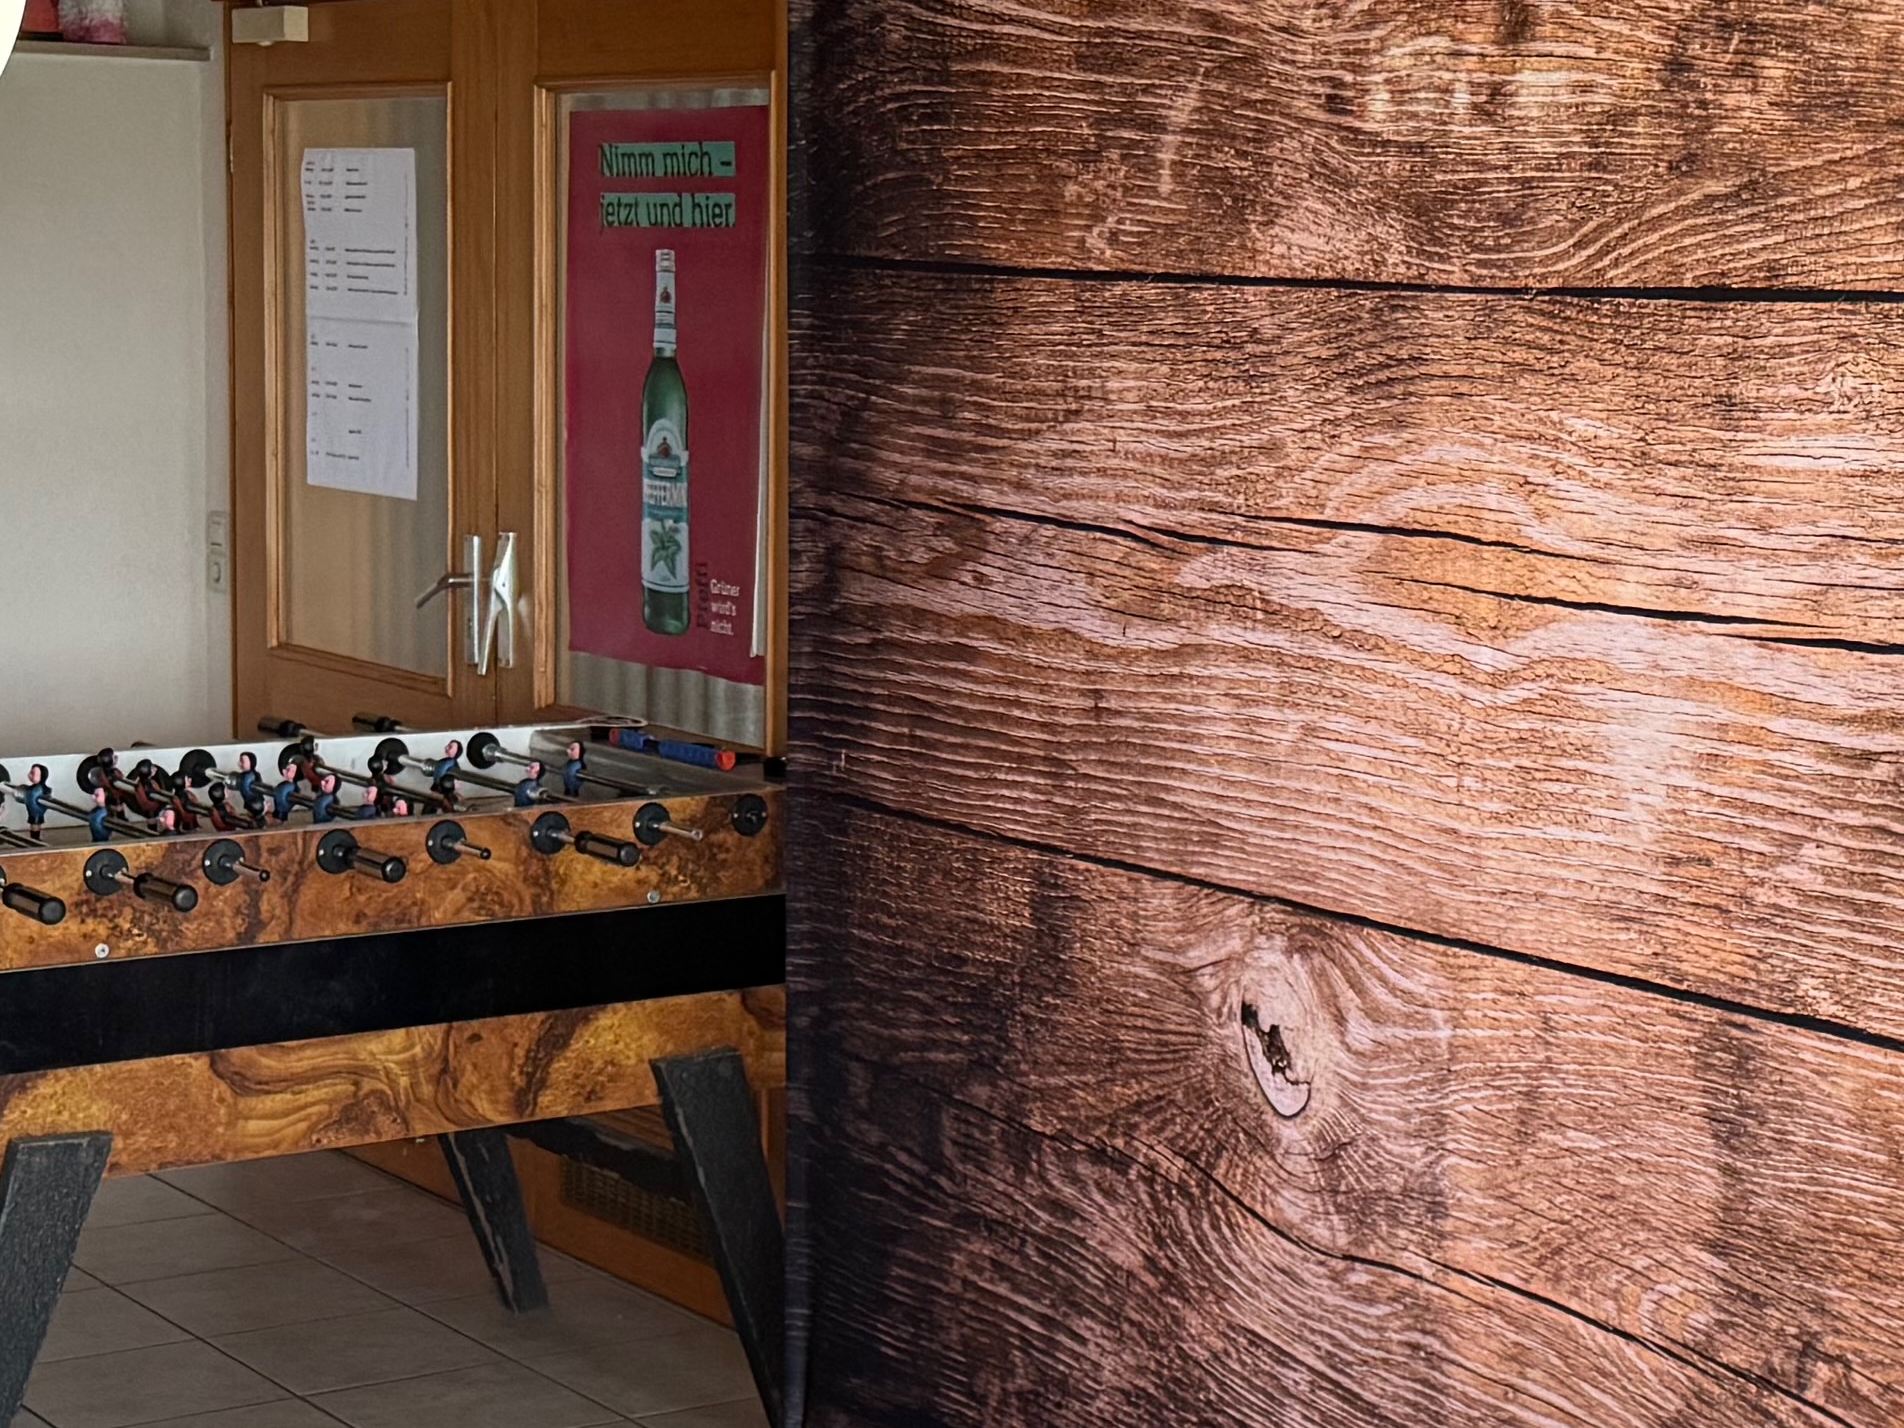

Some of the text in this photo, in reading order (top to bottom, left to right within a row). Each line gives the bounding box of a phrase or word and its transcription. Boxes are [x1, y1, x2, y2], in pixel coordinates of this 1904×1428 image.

[599, 143, 656, 178] Nimm
[662, 142, 713, 177] mich
[599, 194, 737, 235] jetzt und hier.
